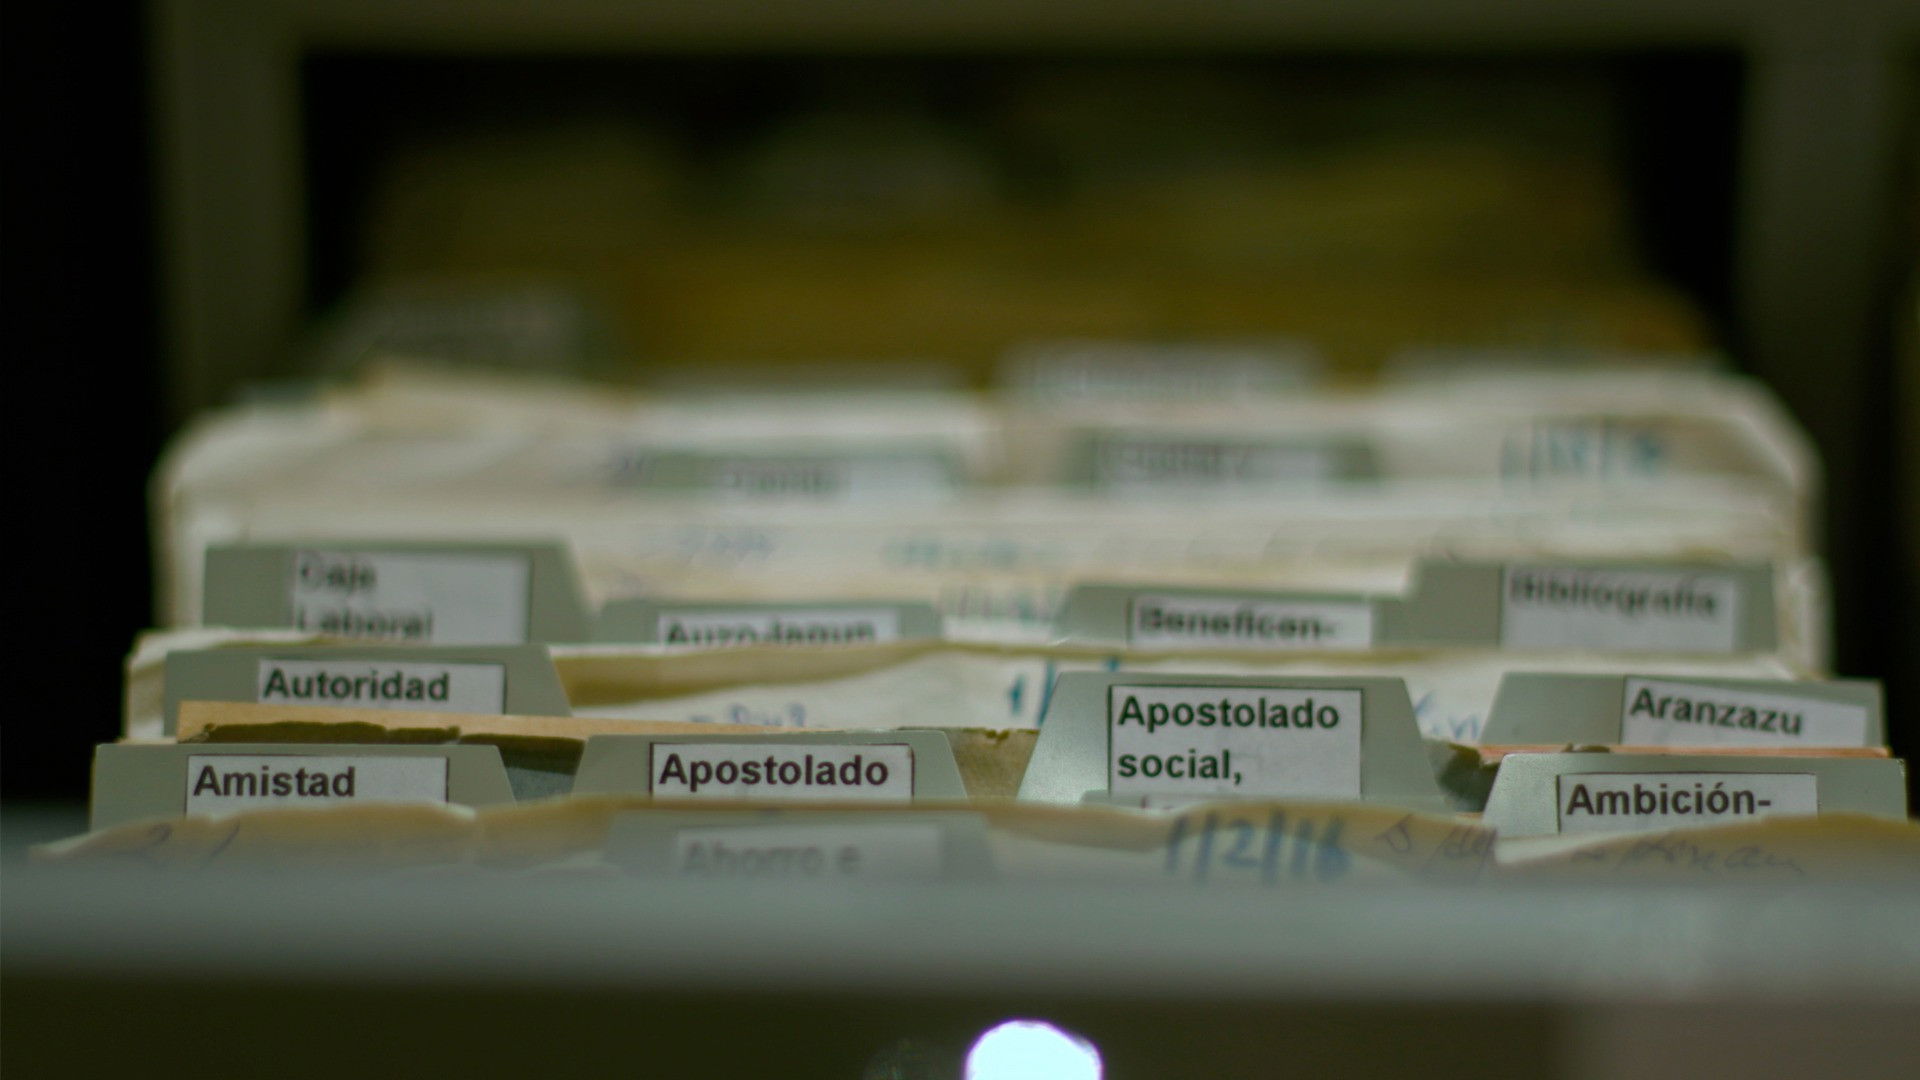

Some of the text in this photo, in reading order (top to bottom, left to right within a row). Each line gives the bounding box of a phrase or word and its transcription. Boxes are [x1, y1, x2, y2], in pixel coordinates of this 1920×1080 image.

[1139, 605, 1338, 638] Beneficen-
[263, 667, 450, 702] Autoridad
[1117, 695, 1340, 734] Apostolado
[1629, 687, 1804, 736] Aranzazu
[193, 764, 355, 799] Amistad
[658, 753, 889, 792] Apostolado
[1117, 749, 1243, 785] social,
[1565, 782, 1772, 817] Ambición-
